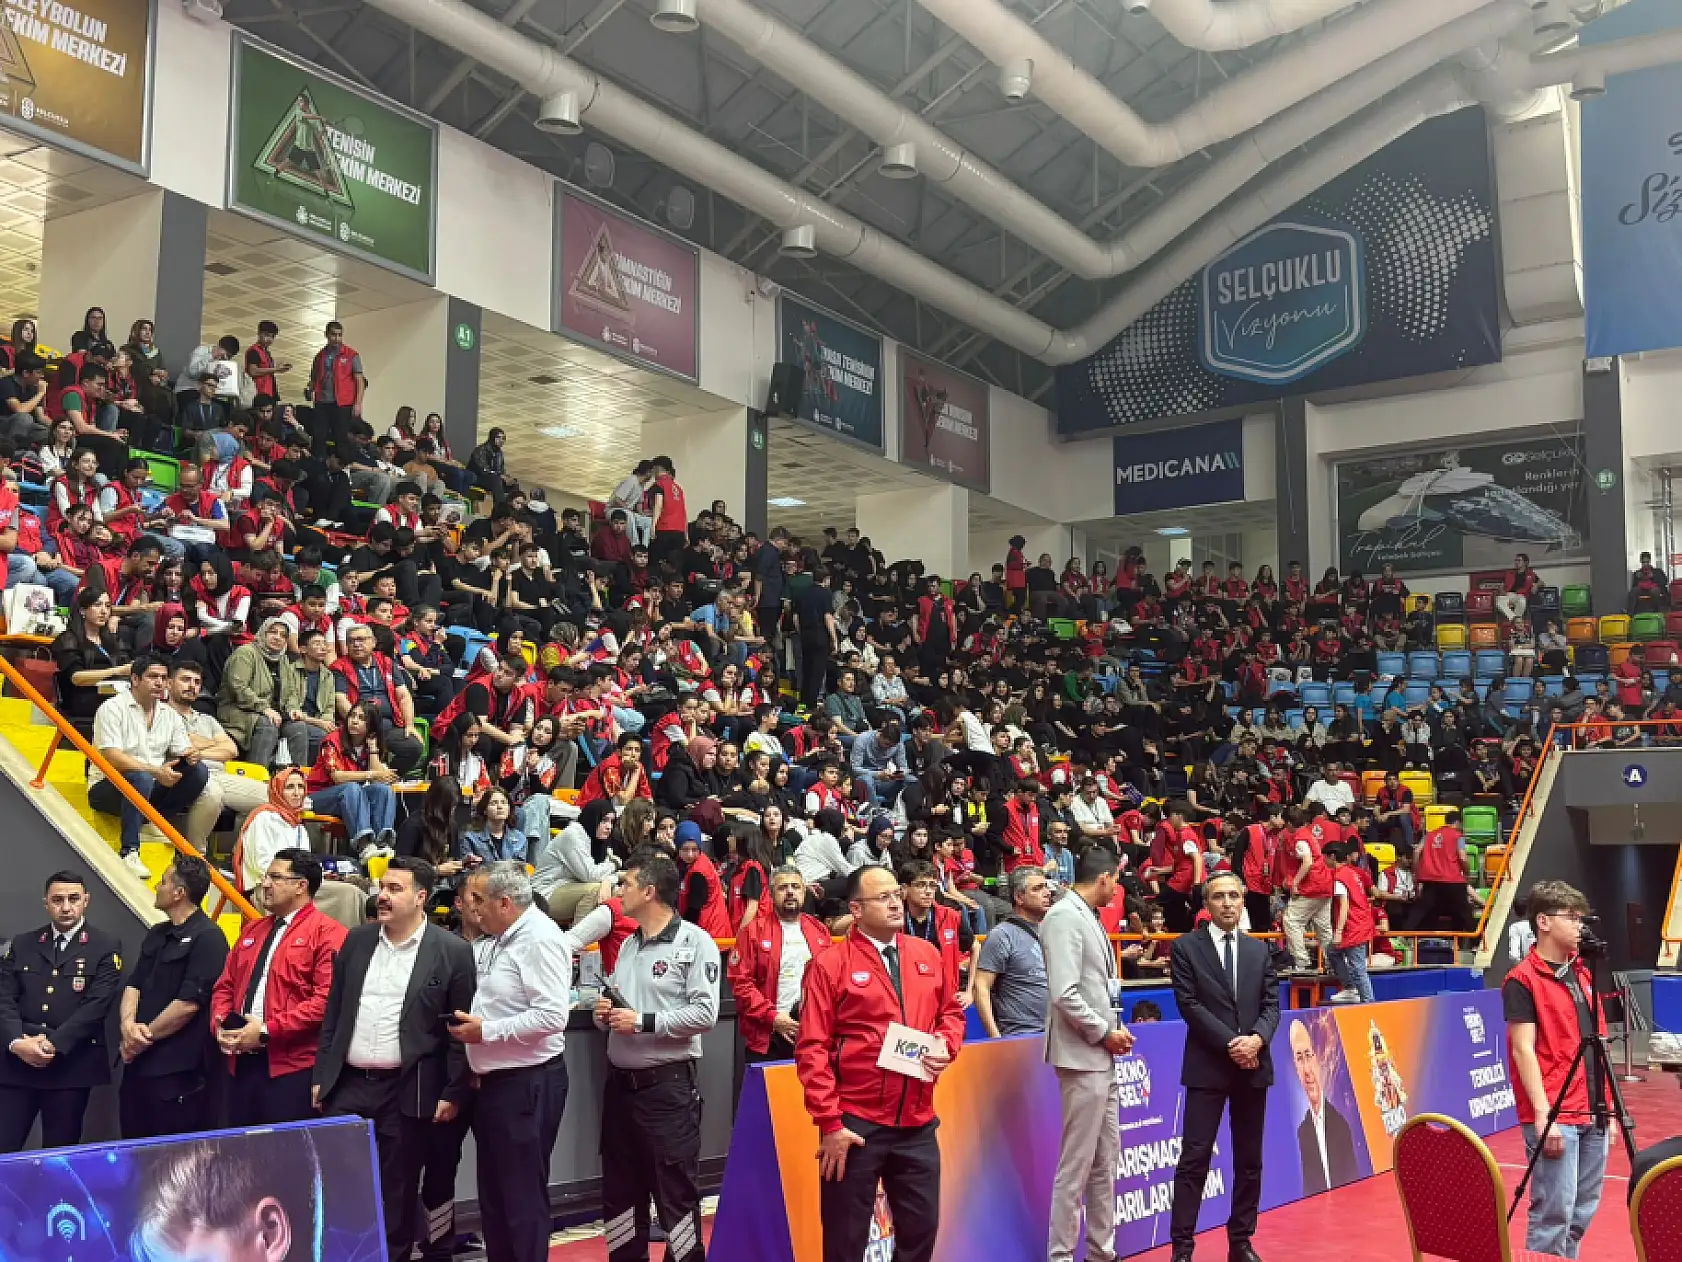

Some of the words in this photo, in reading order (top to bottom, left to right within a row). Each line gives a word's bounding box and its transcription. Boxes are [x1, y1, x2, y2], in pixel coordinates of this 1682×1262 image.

[51, 28, 127, 78] MERKEZİ
[1217, 249, 1341, 304] SELÇUKLU
[1221, 301, 1337, 350] Vizyonu
[1116, 452, 1226, 485] MEDICANA
[1628, 768, 1643, 783] A
